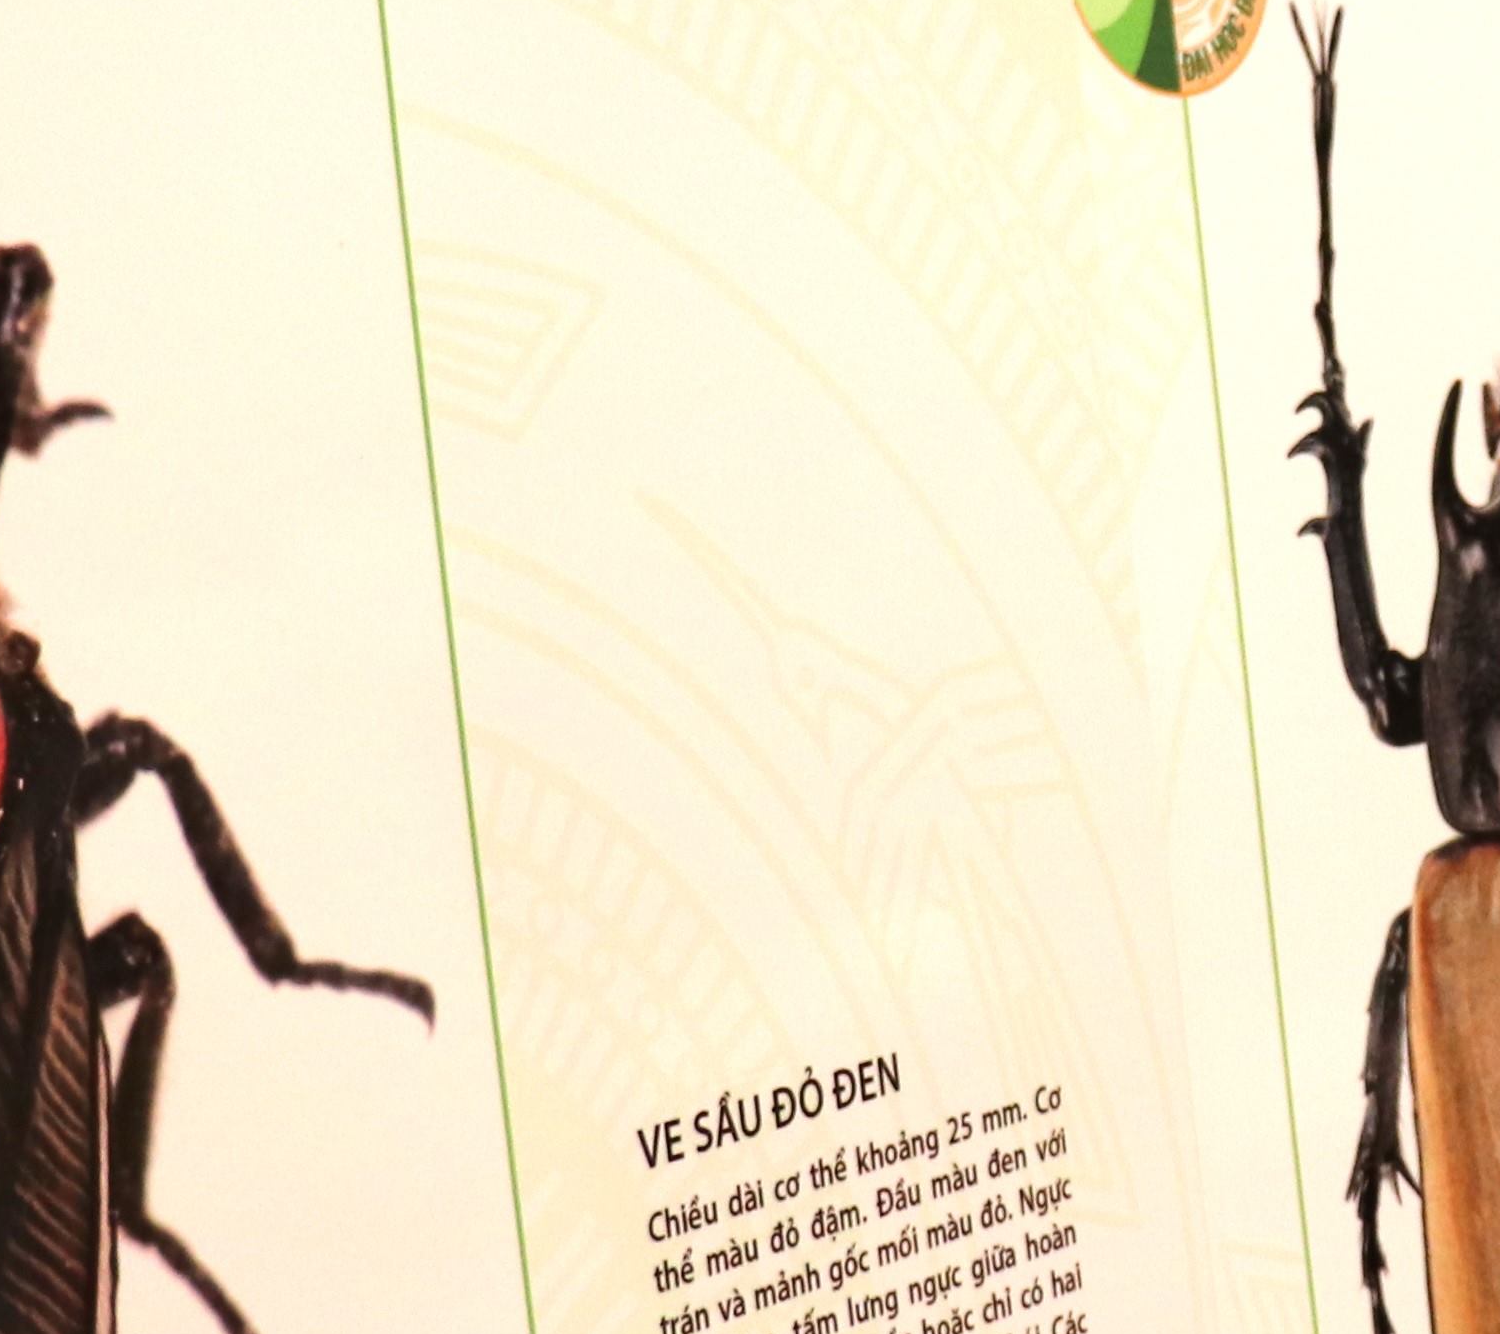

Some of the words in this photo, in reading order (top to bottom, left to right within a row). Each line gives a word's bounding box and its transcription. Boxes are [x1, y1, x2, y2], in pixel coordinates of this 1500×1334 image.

[635, 1116, 686, 1169] VE
[692, 1090, 763, 1154] SẦU
[770, 1064, 825, 1130] ĐỎ
[831, 1051, 901, 1111] ĐEN
[727, 1179, 765, 1217] dài
[772, 1170, 801, 1203] cơ
[808, 1145, 848, 1191] thể
[854, 1128, 940, 1176] khoảng
[945, 1110, 974, 1146] 25
[980, 1101, 1029, 1134] mm.
[1033, 1084, 1062, 1115] Cơ
[652, 1246, 696, 1293] thể
[705, 1237, 760, 1277] màu
[769, 1216, 801, 1254] đỏ
[809, 1203, 868, 1242] đậm.
[929, 1162, 979, 1199] màu
[986, 1146, 1028, 1179] đen
[1034, 1126, 1068, 1162] với
[716, 1287, 747, 1323] và
[753, 1261, 822, 1311] mảnh
[827, 1242, 871, 1292] gốc
[925, 1212, 974, 1250] màu
[979, 1193, 1014, 1229] đỏ.
[1017, 1176, 1073, 1217] Ngực
